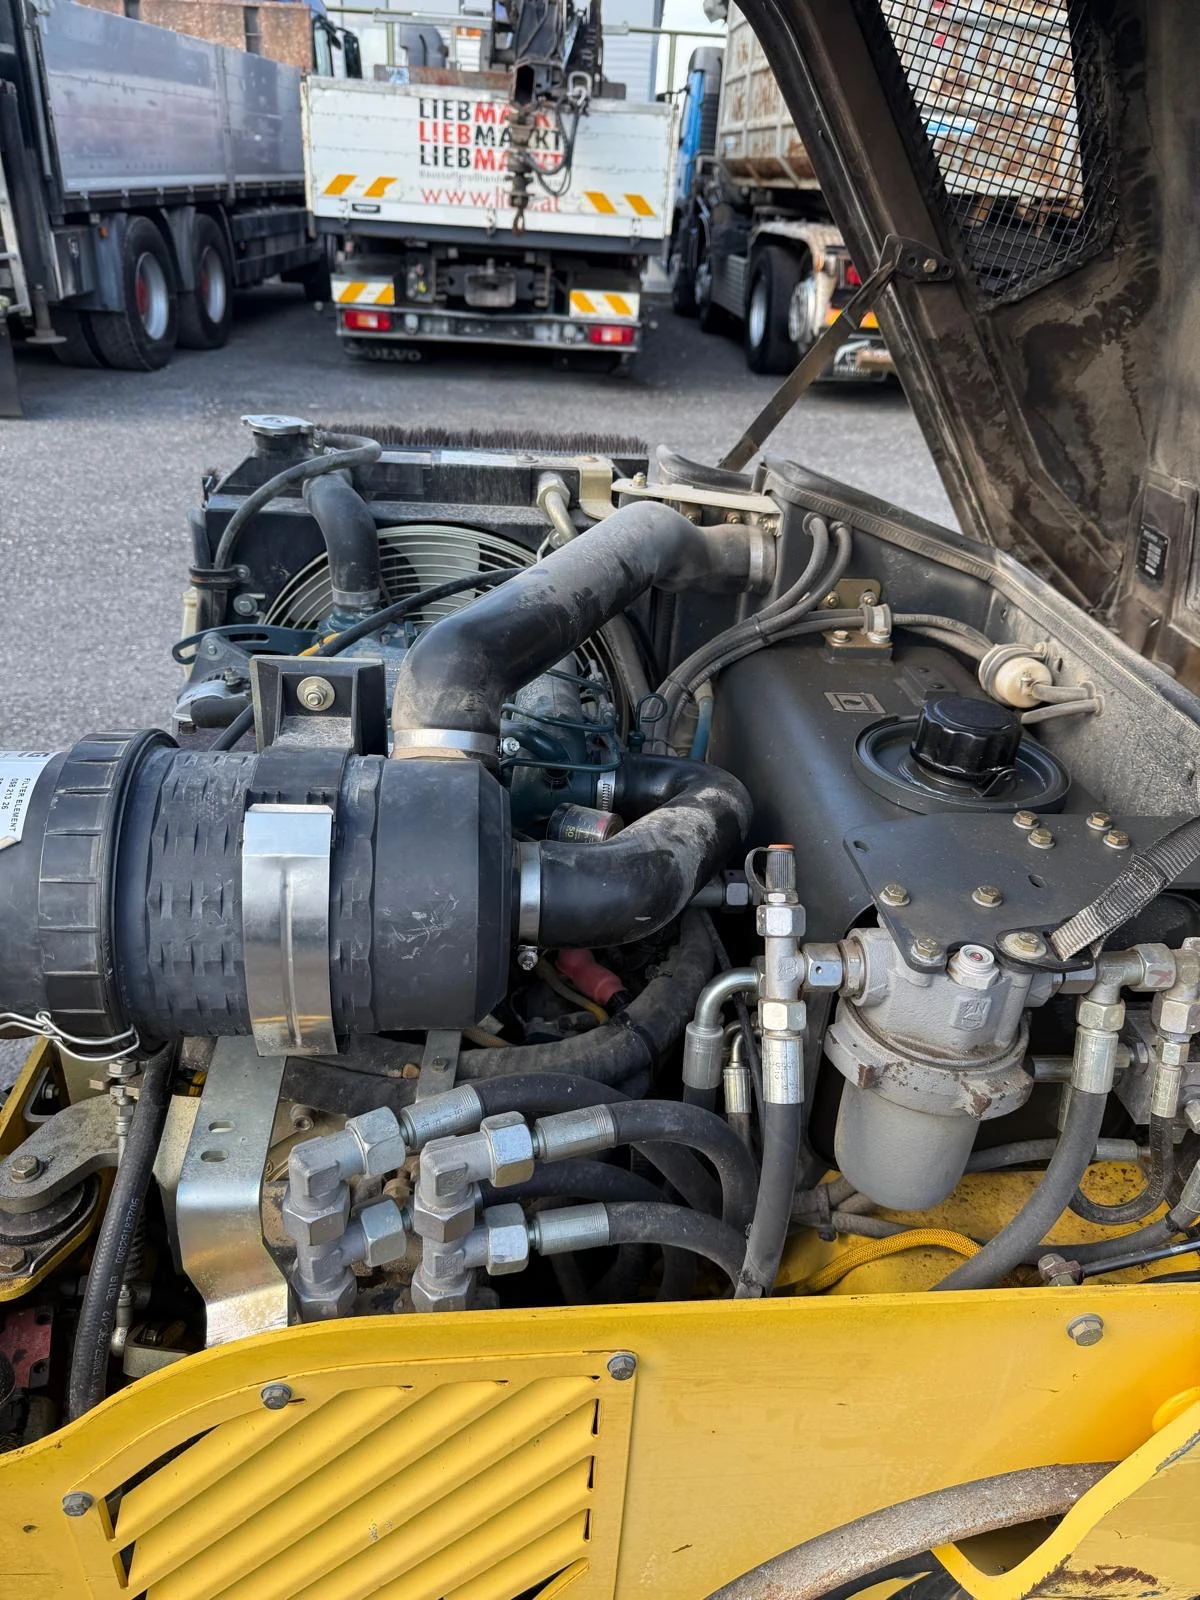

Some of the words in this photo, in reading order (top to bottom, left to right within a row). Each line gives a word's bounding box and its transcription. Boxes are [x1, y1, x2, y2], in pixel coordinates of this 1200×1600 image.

[418, 121, 562, 150] LIEBMAKT
[18, 777, 31, 797] FILTER
[9, 799, 23, 832] ELEMENT
